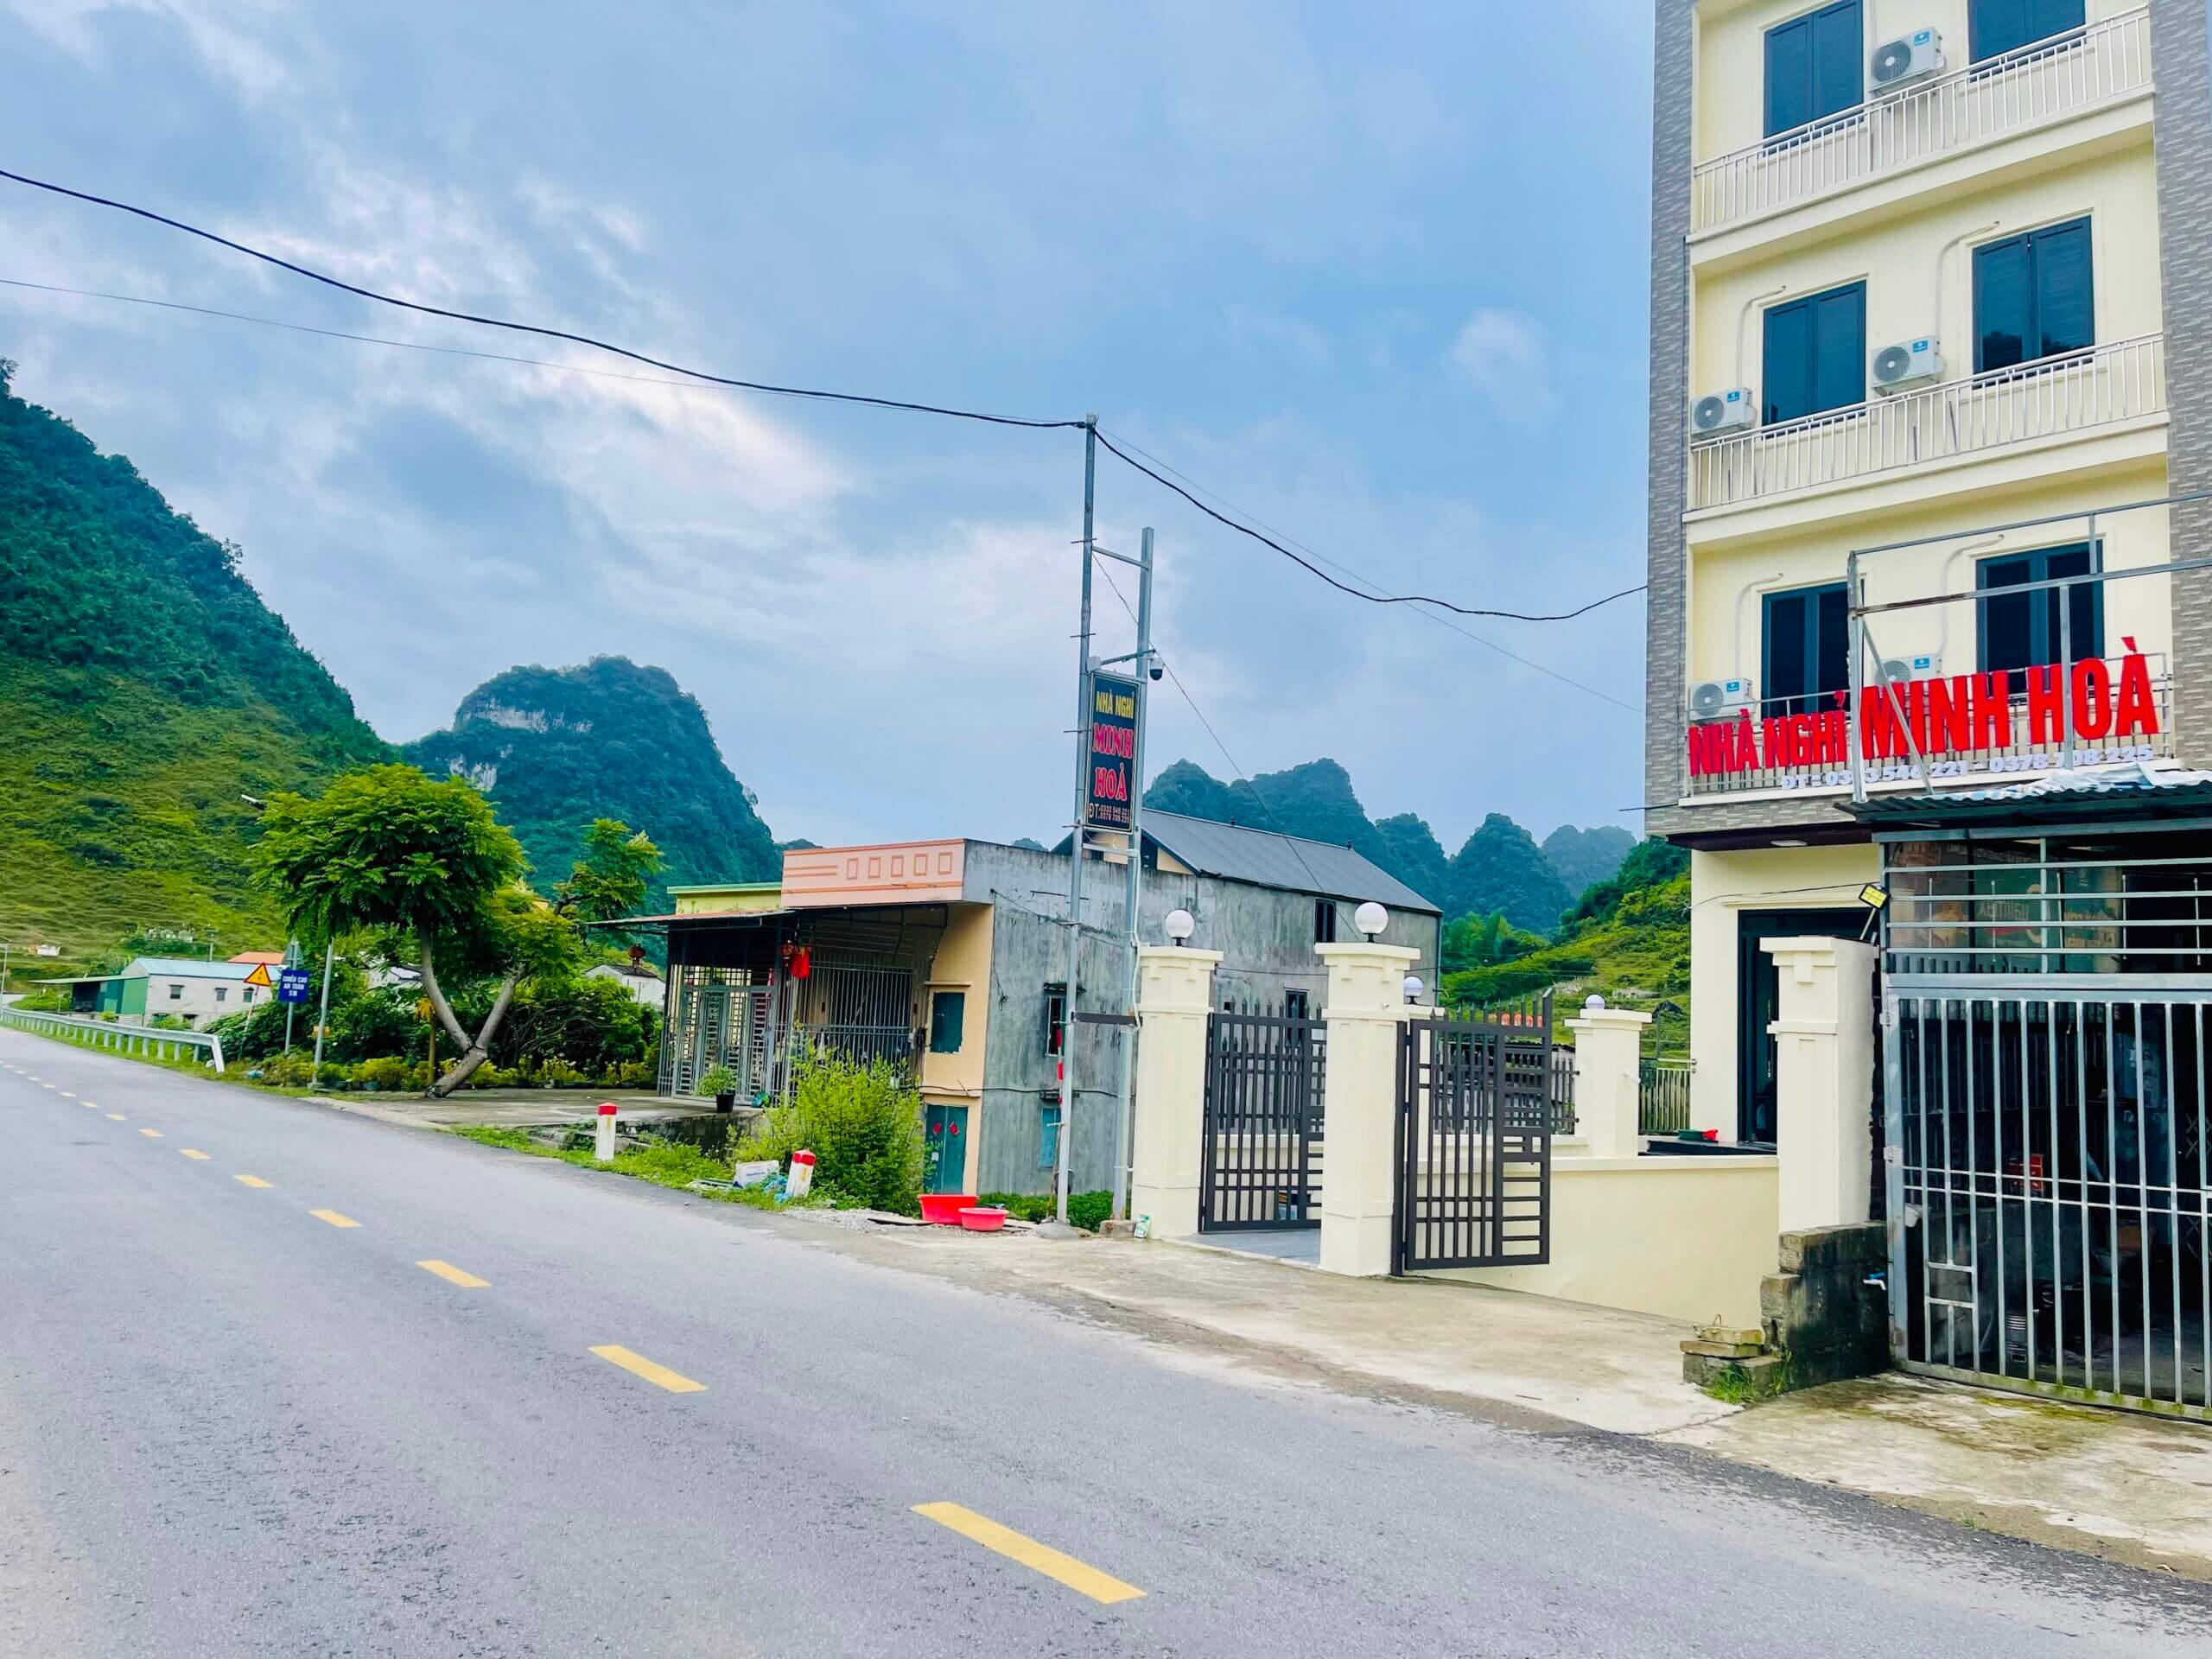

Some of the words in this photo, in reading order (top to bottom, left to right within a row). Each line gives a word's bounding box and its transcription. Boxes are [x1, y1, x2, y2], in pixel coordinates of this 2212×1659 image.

[1096, 690, 1112, 715] NHÀ
[1688, 709, 1759, 776] NHÀ
[1763, 691, 1847, 768] NGHỈ
[1860, 671, 2011, 760] MINH
[2028, 636, 2158, 744] HOÀ
[1092, 722, 1135, 759] MINH
[1094, 763, 1127, 802] HOÀ
[1825, 766, 1879, 786] 033
[1929, 760, 1968, 779] 221
[1990, 753, 2048, 772] 0378
[2105, 744, 2154, 765] 225
